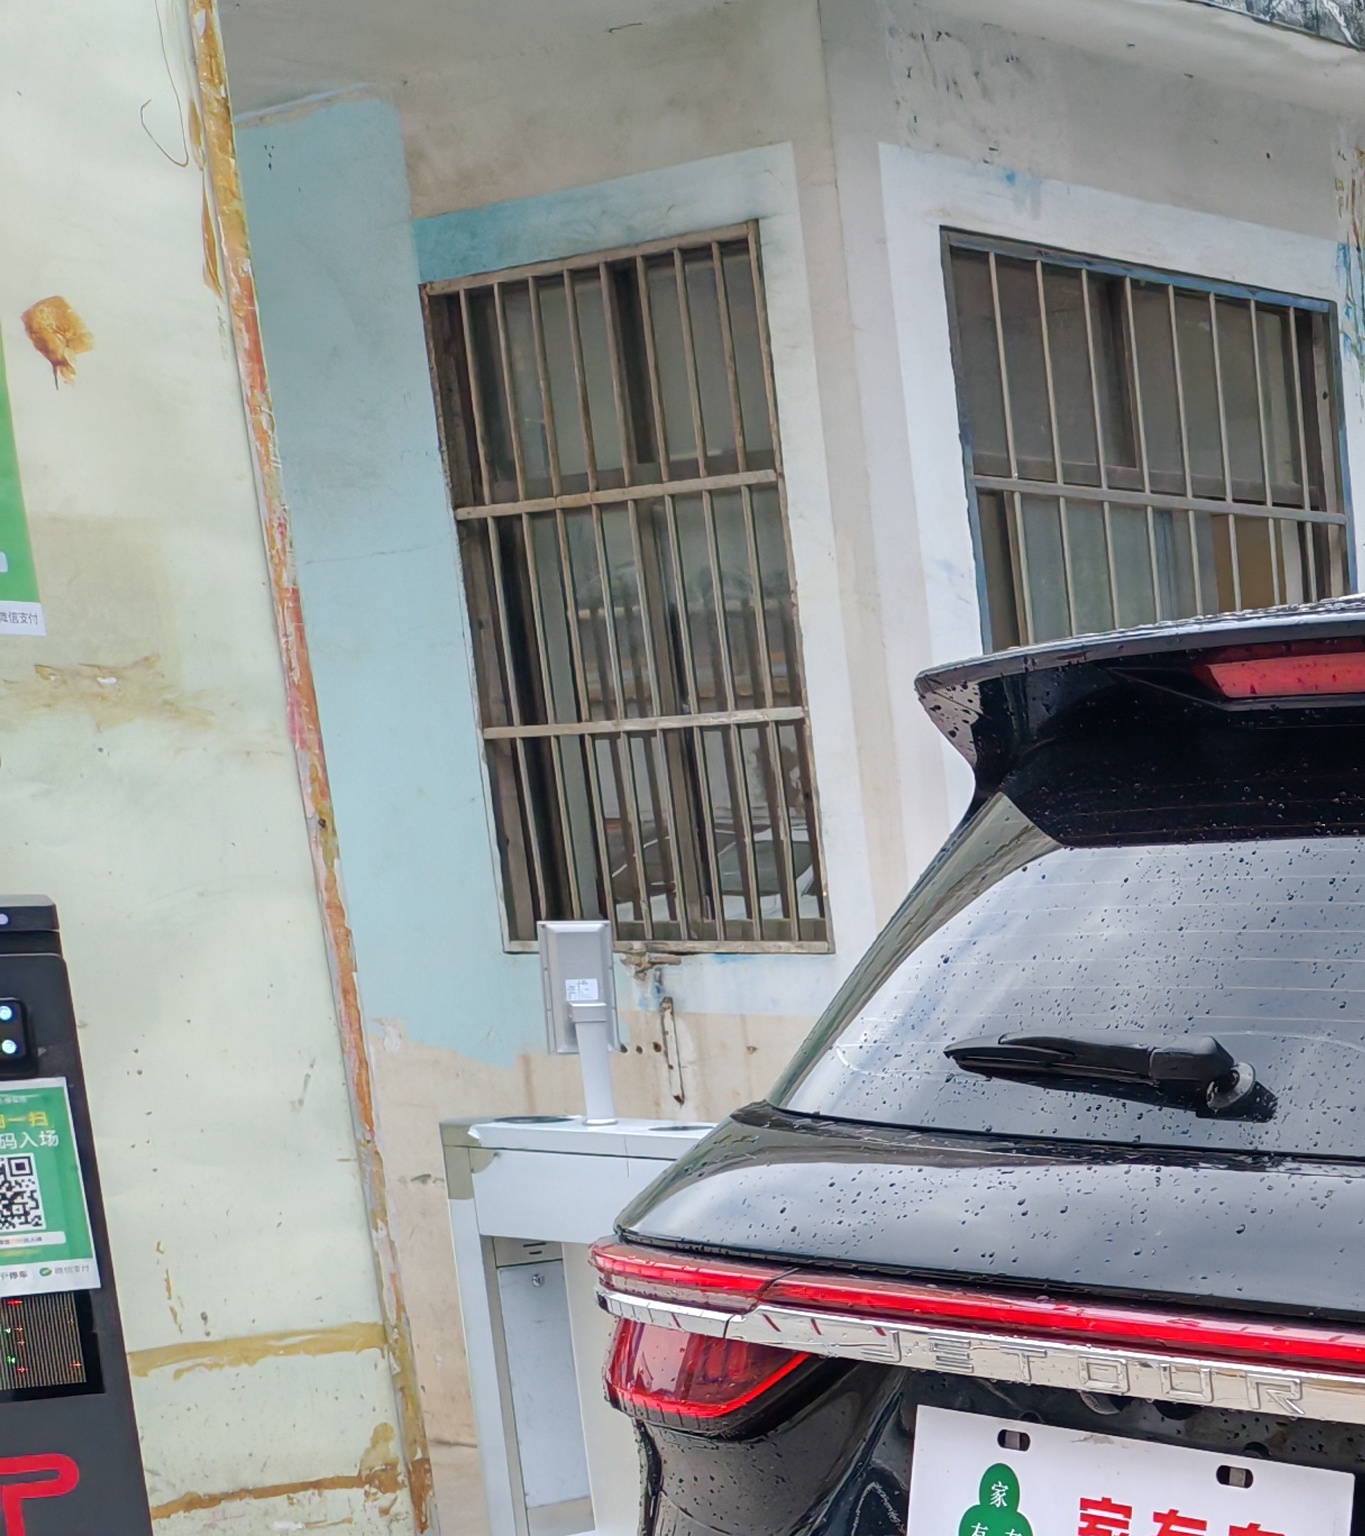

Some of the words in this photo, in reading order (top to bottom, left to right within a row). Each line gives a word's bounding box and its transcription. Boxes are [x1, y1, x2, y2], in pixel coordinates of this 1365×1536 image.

[0, 1111, 49, 1130] 一扫
[860, 1329, 1305, 1416] JETOUR
[990, 1480, 1009, 1508] 家
